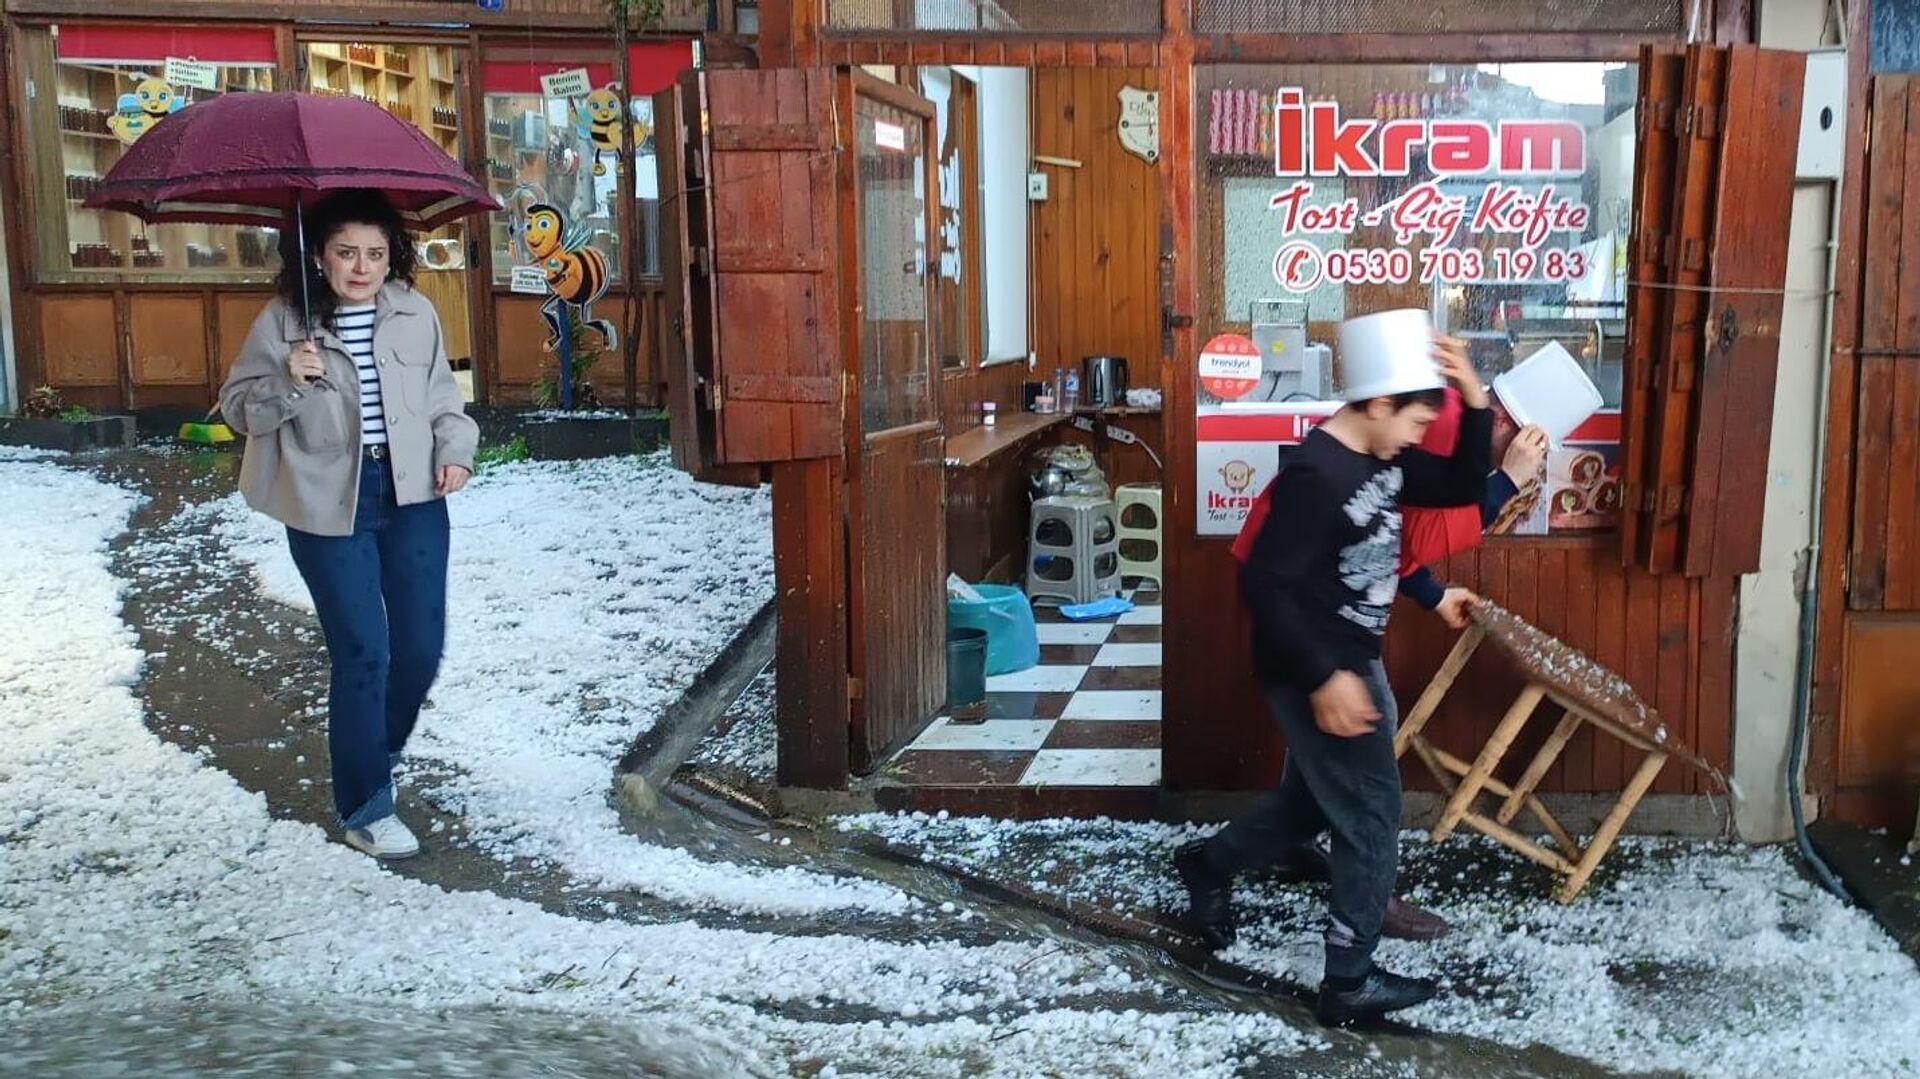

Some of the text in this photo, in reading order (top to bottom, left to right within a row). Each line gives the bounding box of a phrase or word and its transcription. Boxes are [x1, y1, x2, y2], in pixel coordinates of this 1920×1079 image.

[1276, 88, 1585, 176] İkram
[1273, 183, 1356, 234] Tost
[1393, 182, 1464, 246] Çiğ
[1473, 185, 1588, 244] Köfte
[1326, 250, 1586, 281] 0530 703 19 83
[1208, 489, 1252, 509] İkra
